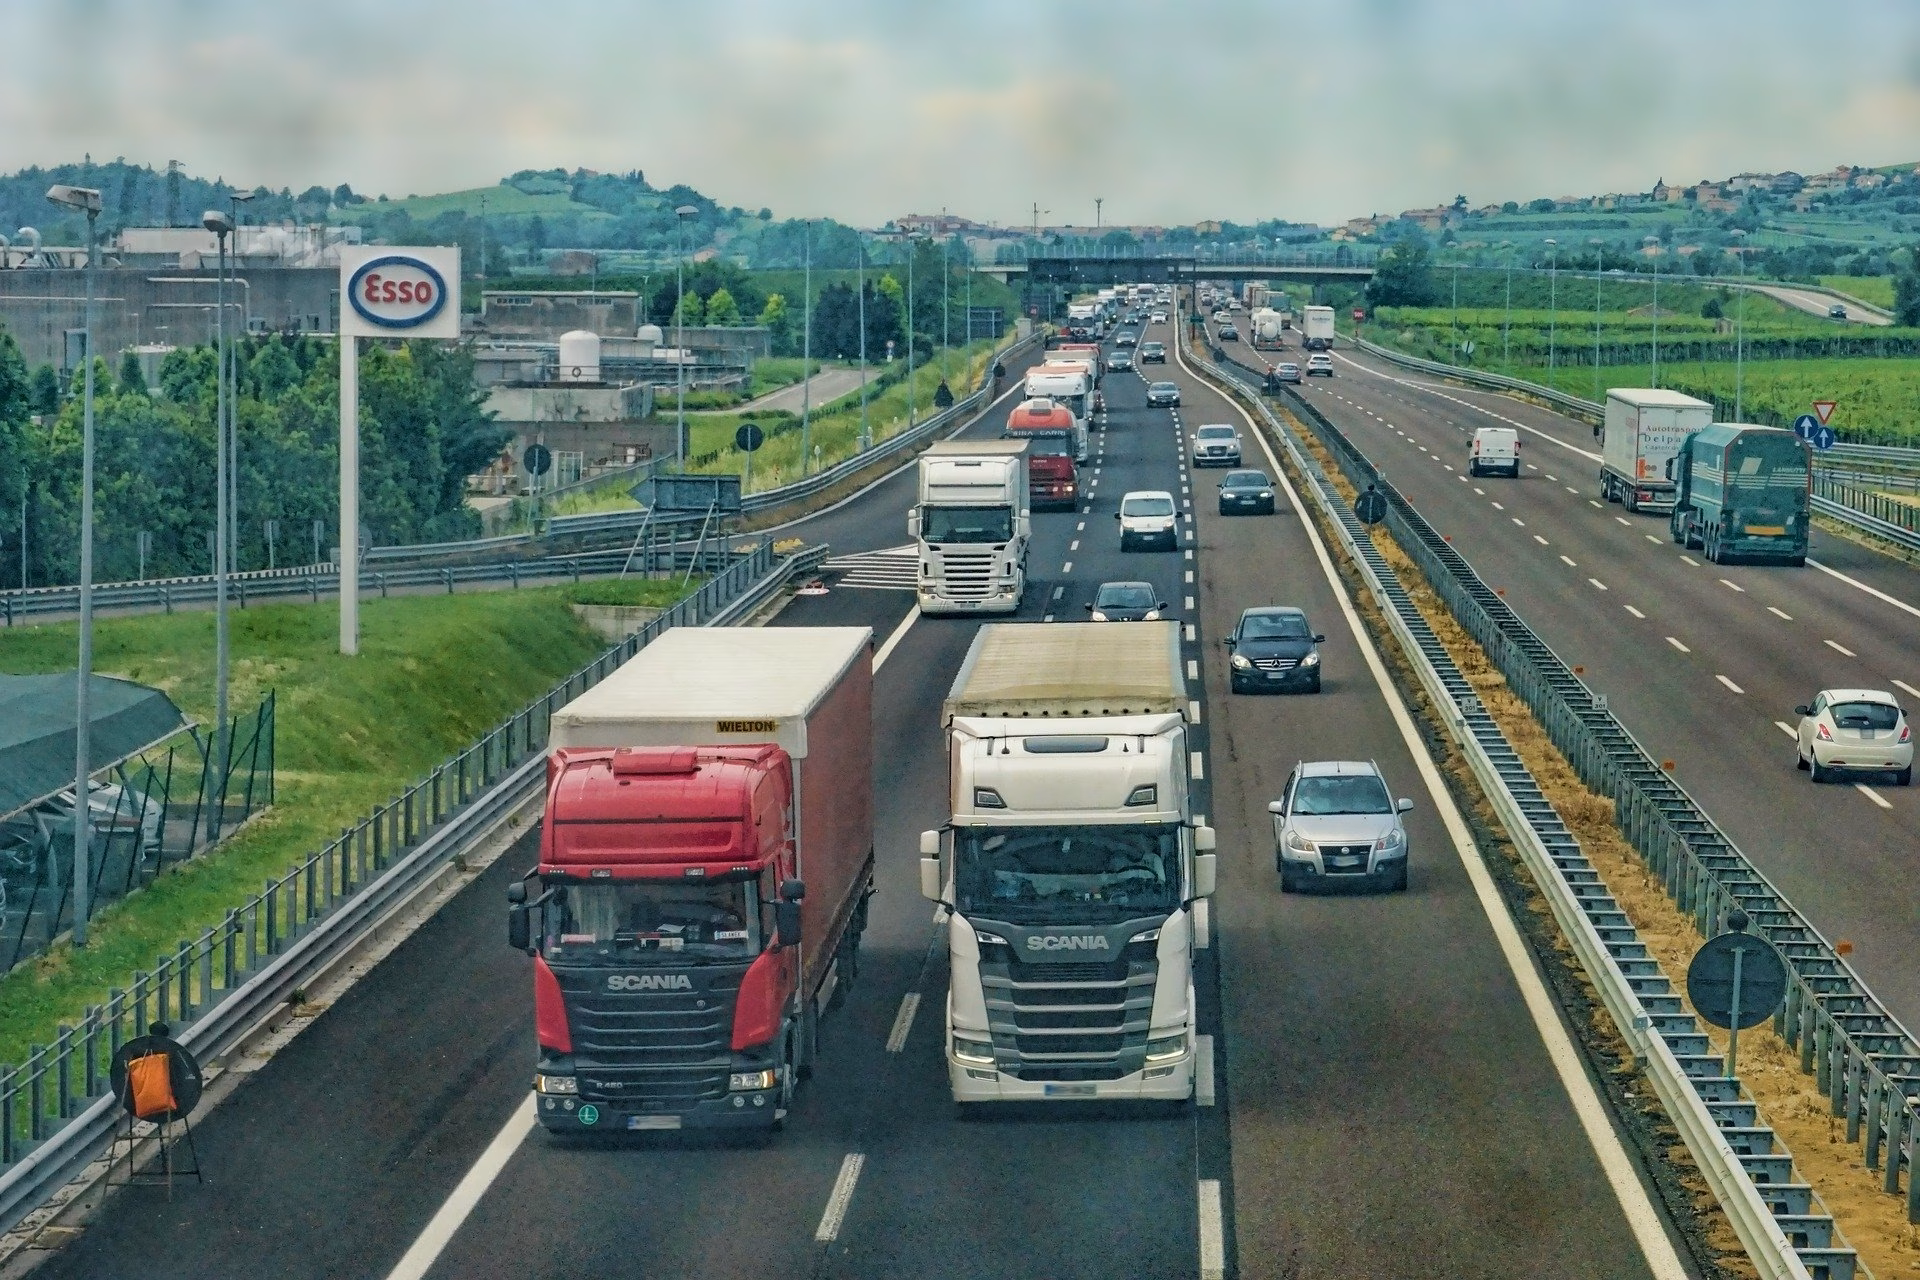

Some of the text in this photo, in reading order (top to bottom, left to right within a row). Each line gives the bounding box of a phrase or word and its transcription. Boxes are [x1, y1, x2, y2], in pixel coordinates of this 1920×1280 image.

[718, 720, 774, 732] WIELTON
[1026, 935, 1110, 951] SCANIA
[607, 974, 693, 991] SCANIA
